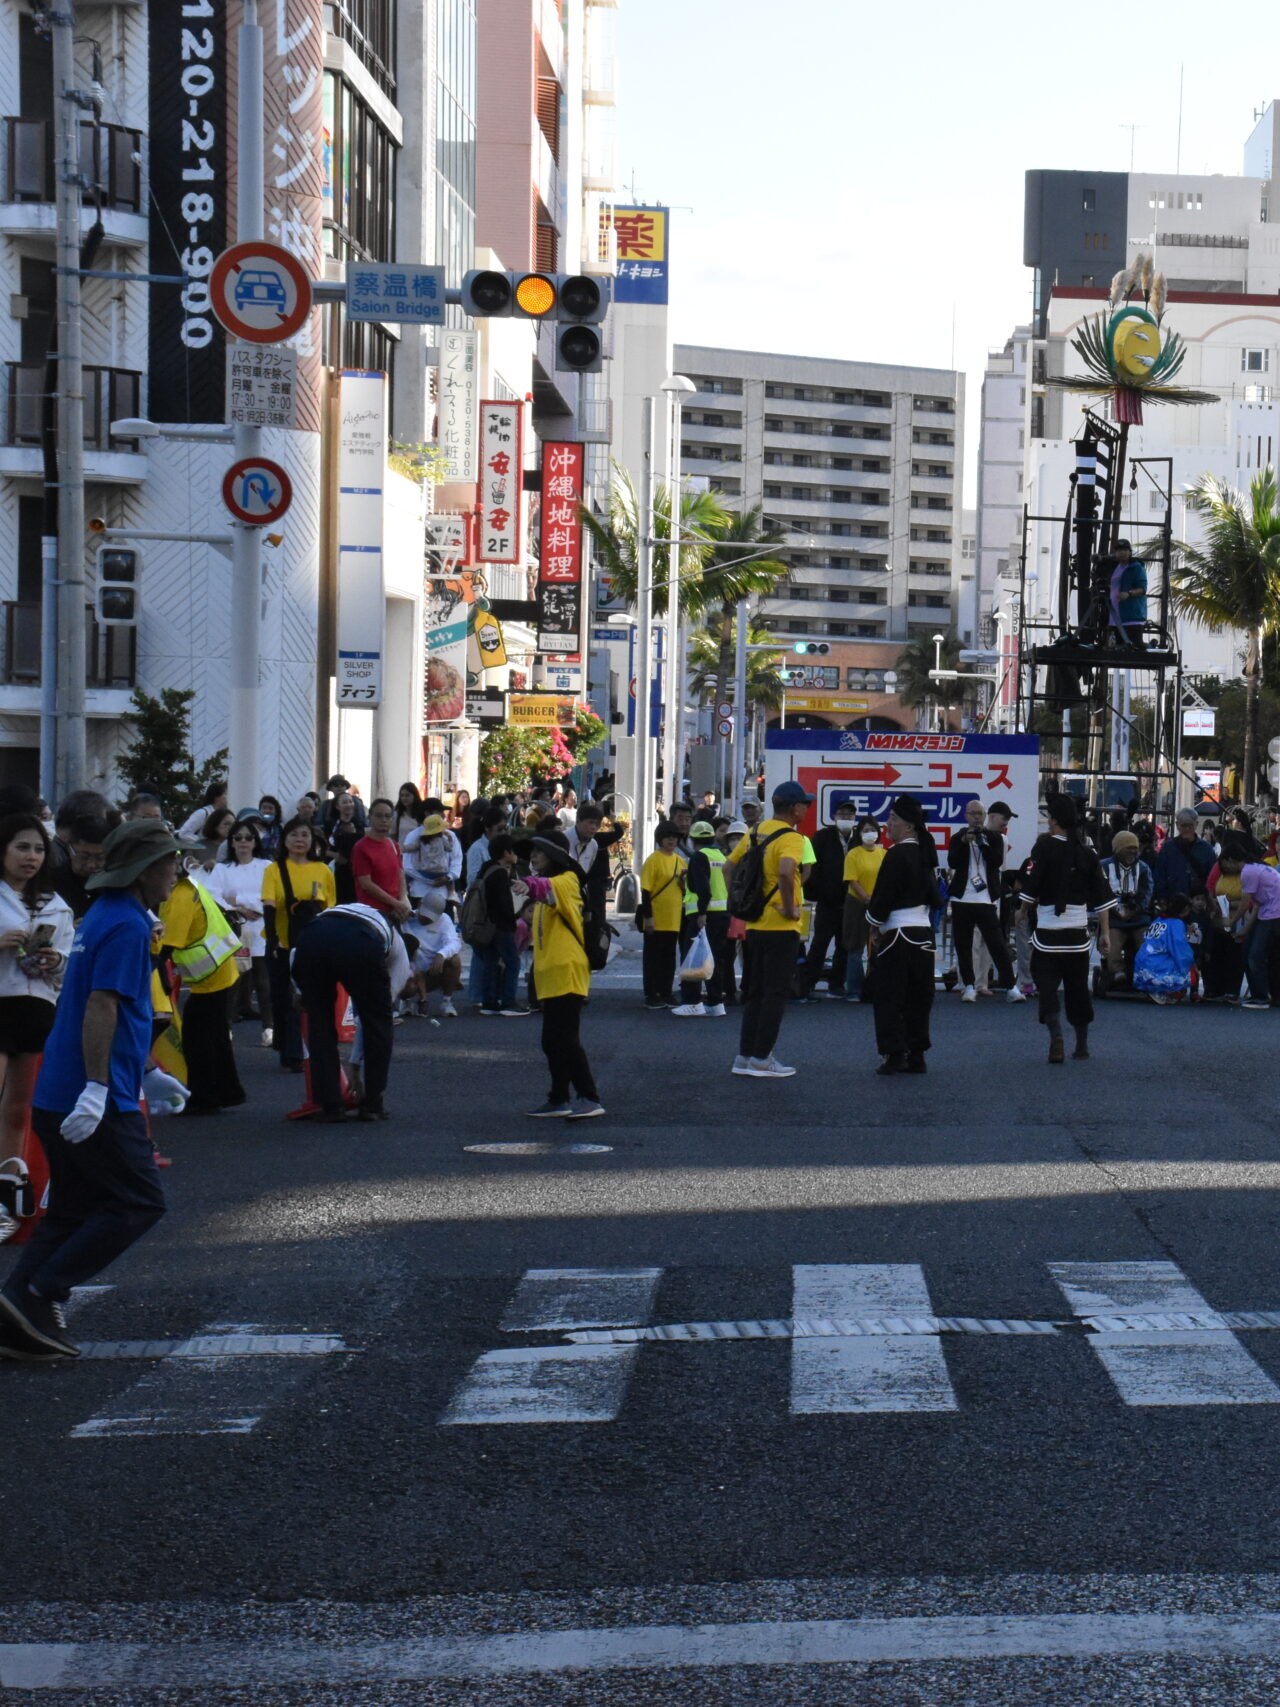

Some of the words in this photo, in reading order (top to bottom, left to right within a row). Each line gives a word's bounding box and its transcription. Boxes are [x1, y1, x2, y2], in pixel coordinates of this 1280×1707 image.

[616, 262, 663, 280] トキヨシ
[354, 272, 438, 299] 蔡温橋
[351, 300, 390, 313] Saion
[396, 302, 439, 318] Bridge
[547, 447, 577, 579] 沖縄地料理
[487, 538, 509, 553] 2F
[344, 661, 374, 670] SILVER
[346, 670, 372, 679] SHOP
[513, 705, 556, 717] BURGER
[866, 733, 967, 752] NAHAマラソン
[929, 763, 1014, 791] コース
[849, 795, 962, 819] モノール
